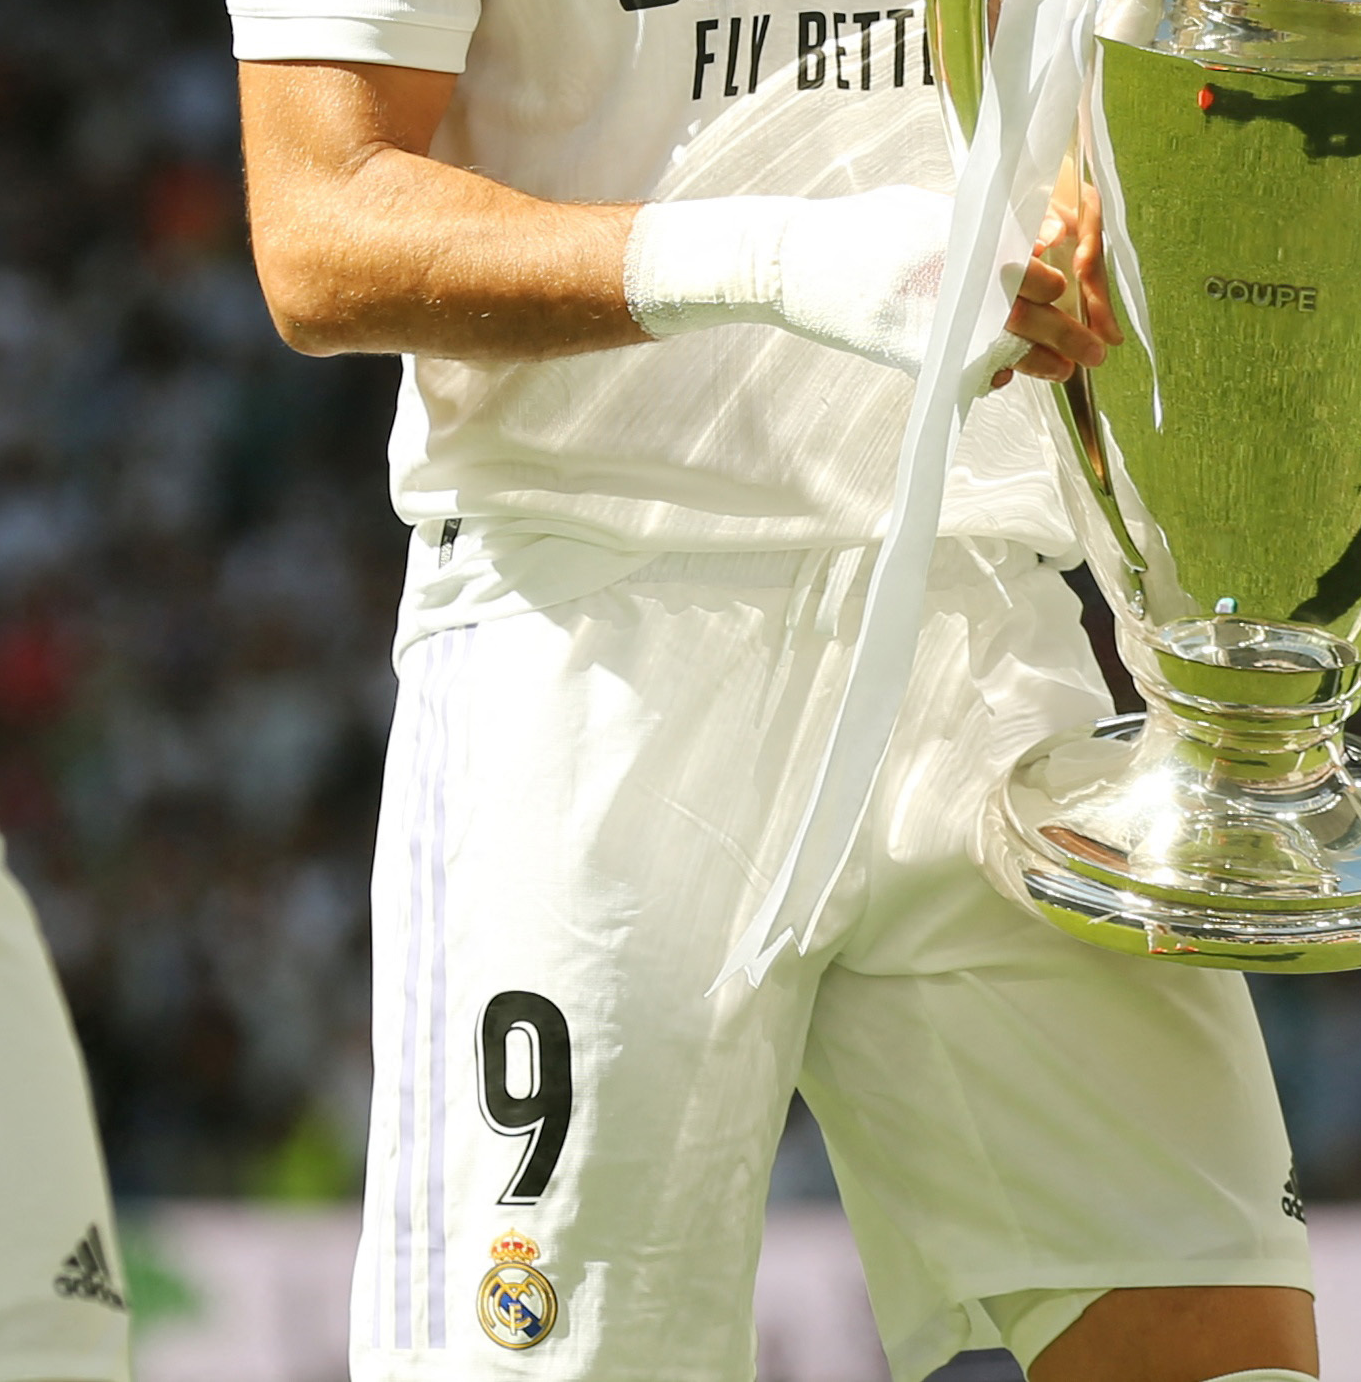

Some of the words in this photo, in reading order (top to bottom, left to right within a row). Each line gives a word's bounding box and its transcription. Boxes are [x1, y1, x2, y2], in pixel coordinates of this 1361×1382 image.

[692, 14, 771, 100] FLY
[1204, 276, 1318, 312] COUPE
[473, 990, 573, 1206] 9
